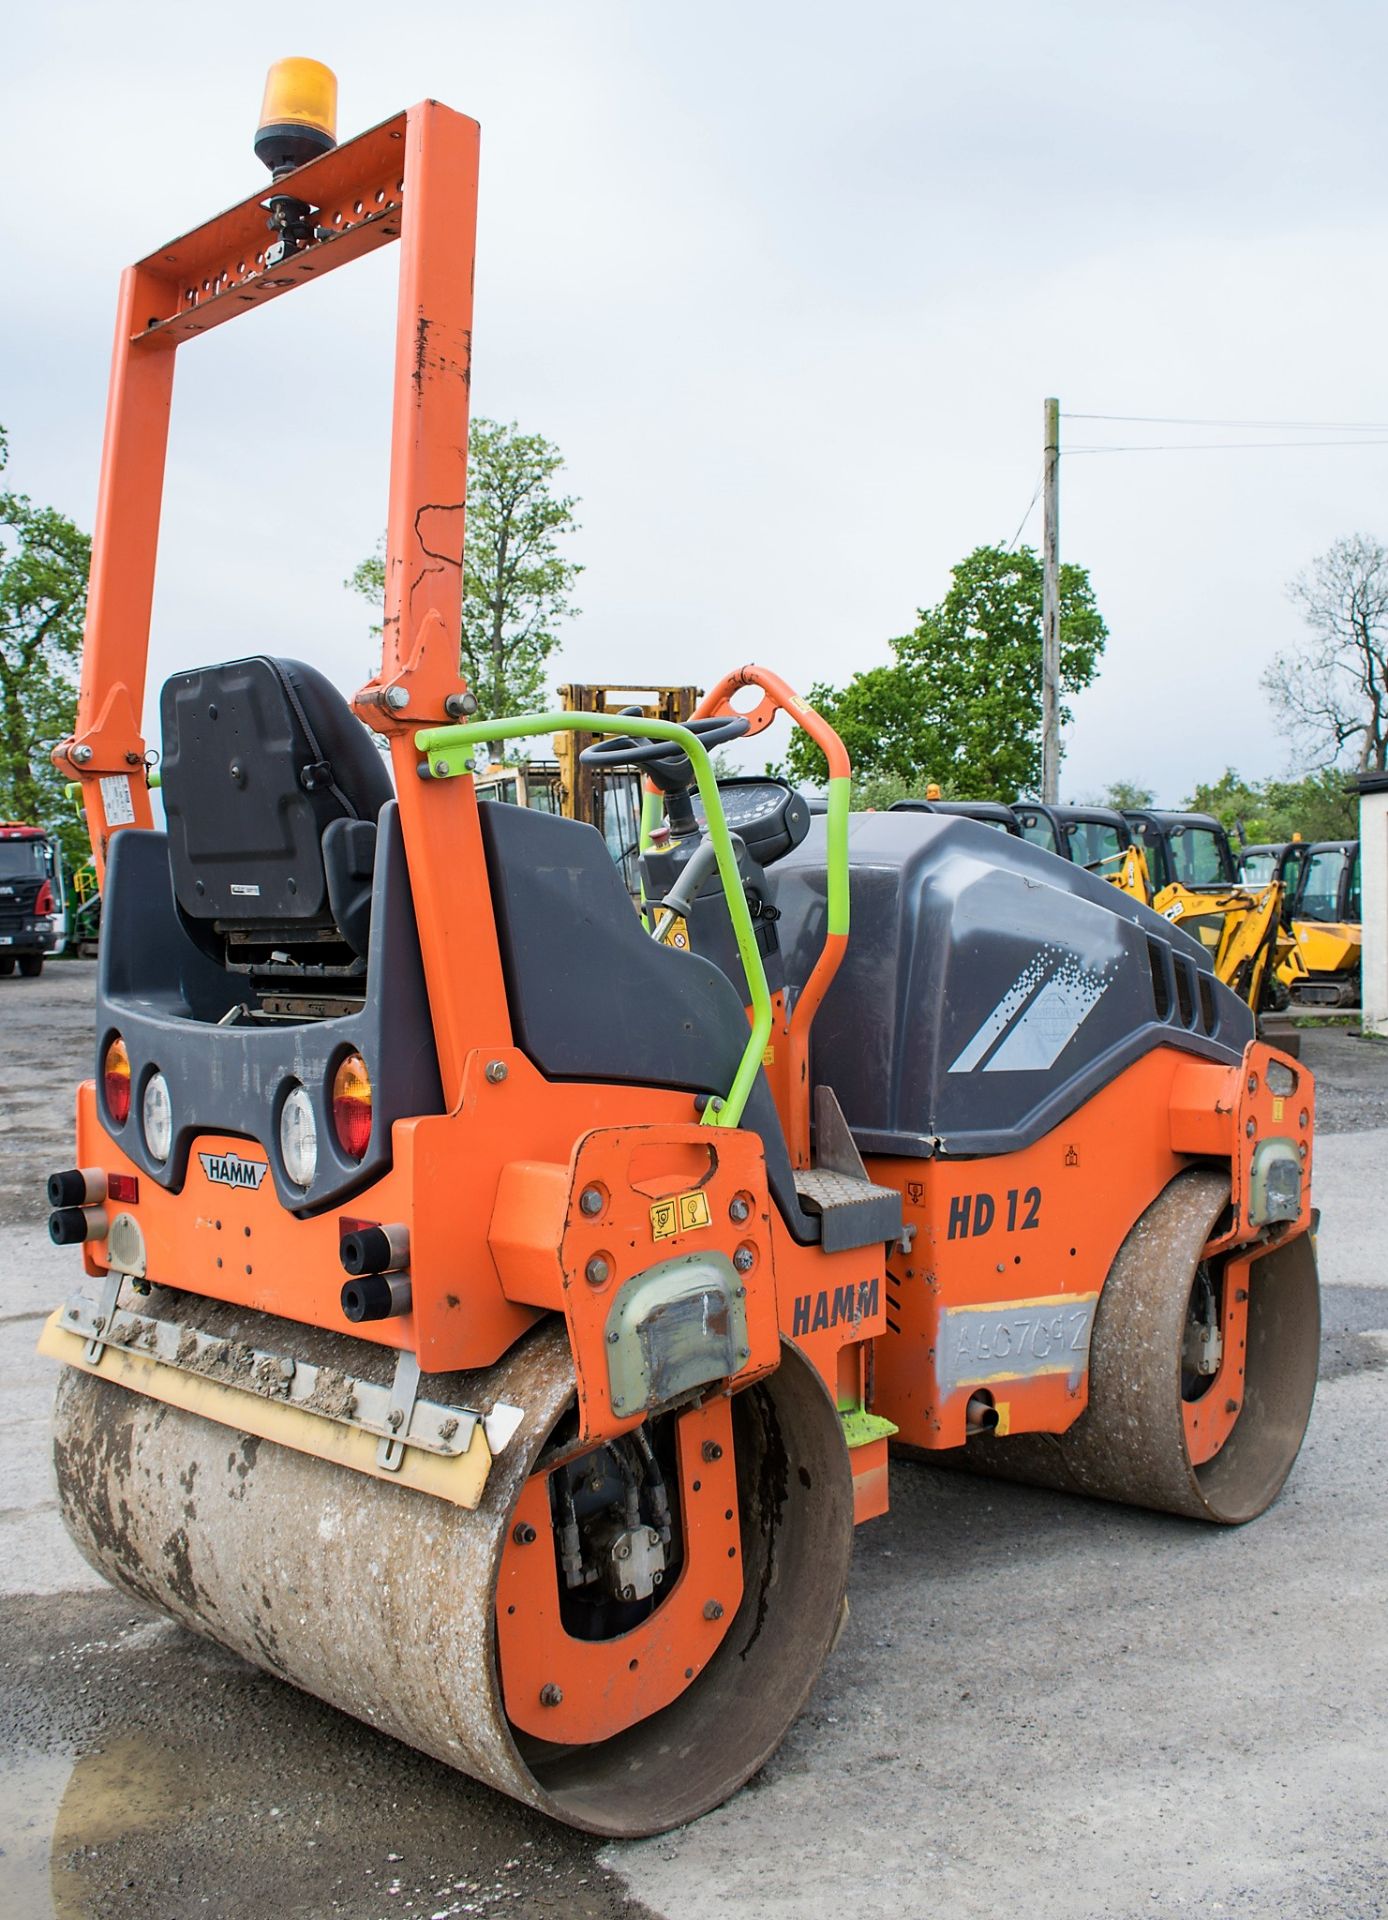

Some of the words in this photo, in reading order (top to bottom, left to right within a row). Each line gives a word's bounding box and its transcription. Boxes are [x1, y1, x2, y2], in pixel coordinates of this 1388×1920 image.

[1162, 902, 1184, 922] CB
[209, 1158, 257, 1186] HAMM
[947, 1193, 995, 1241] HD
[1007, 1186, 1042, 1232] 12
[793, 1278, 879, 1338] HAMM
